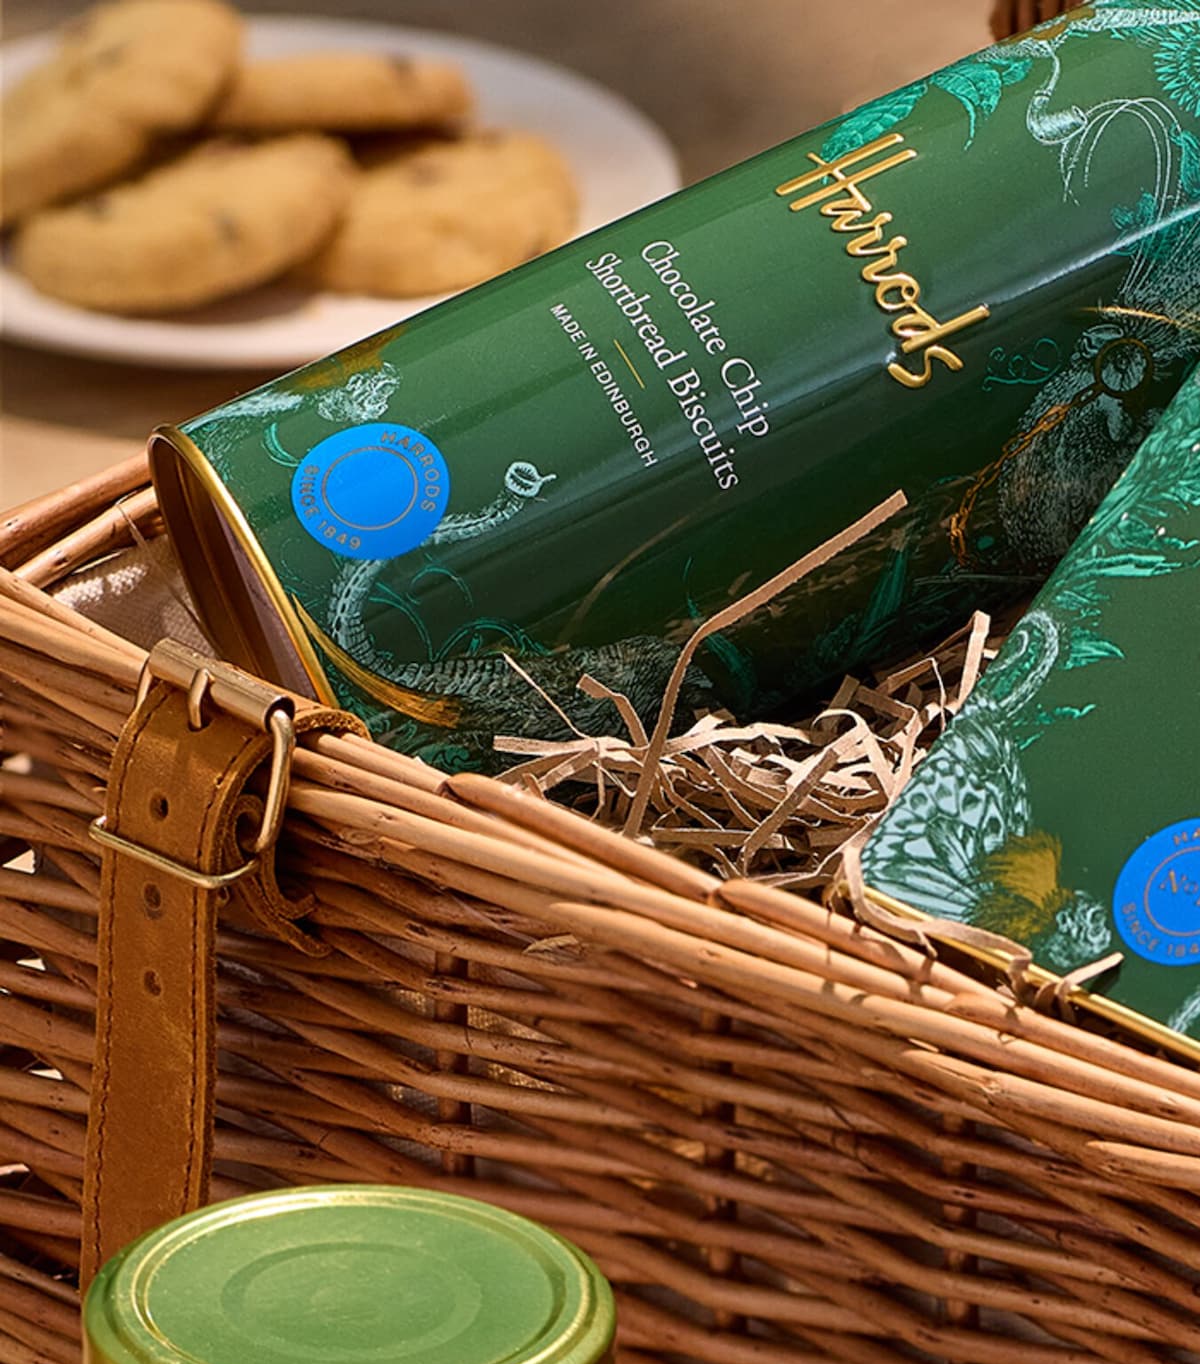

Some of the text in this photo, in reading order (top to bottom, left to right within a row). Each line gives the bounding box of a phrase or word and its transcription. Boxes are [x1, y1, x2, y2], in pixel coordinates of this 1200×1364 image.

[641, 240, 770, 439] Chocolate Chip
[775, 133, 990, 388] Harrods
[549, 304, 659, 468] MADE IN EDINBURGH
[585, 251, 739, 490] Shortbread Biscuits
[299, 464, 361, 549] SINCE 1849
[381, 431, 441, 512] HARRODS
[1121, 902, 1159, 951] SINCE
